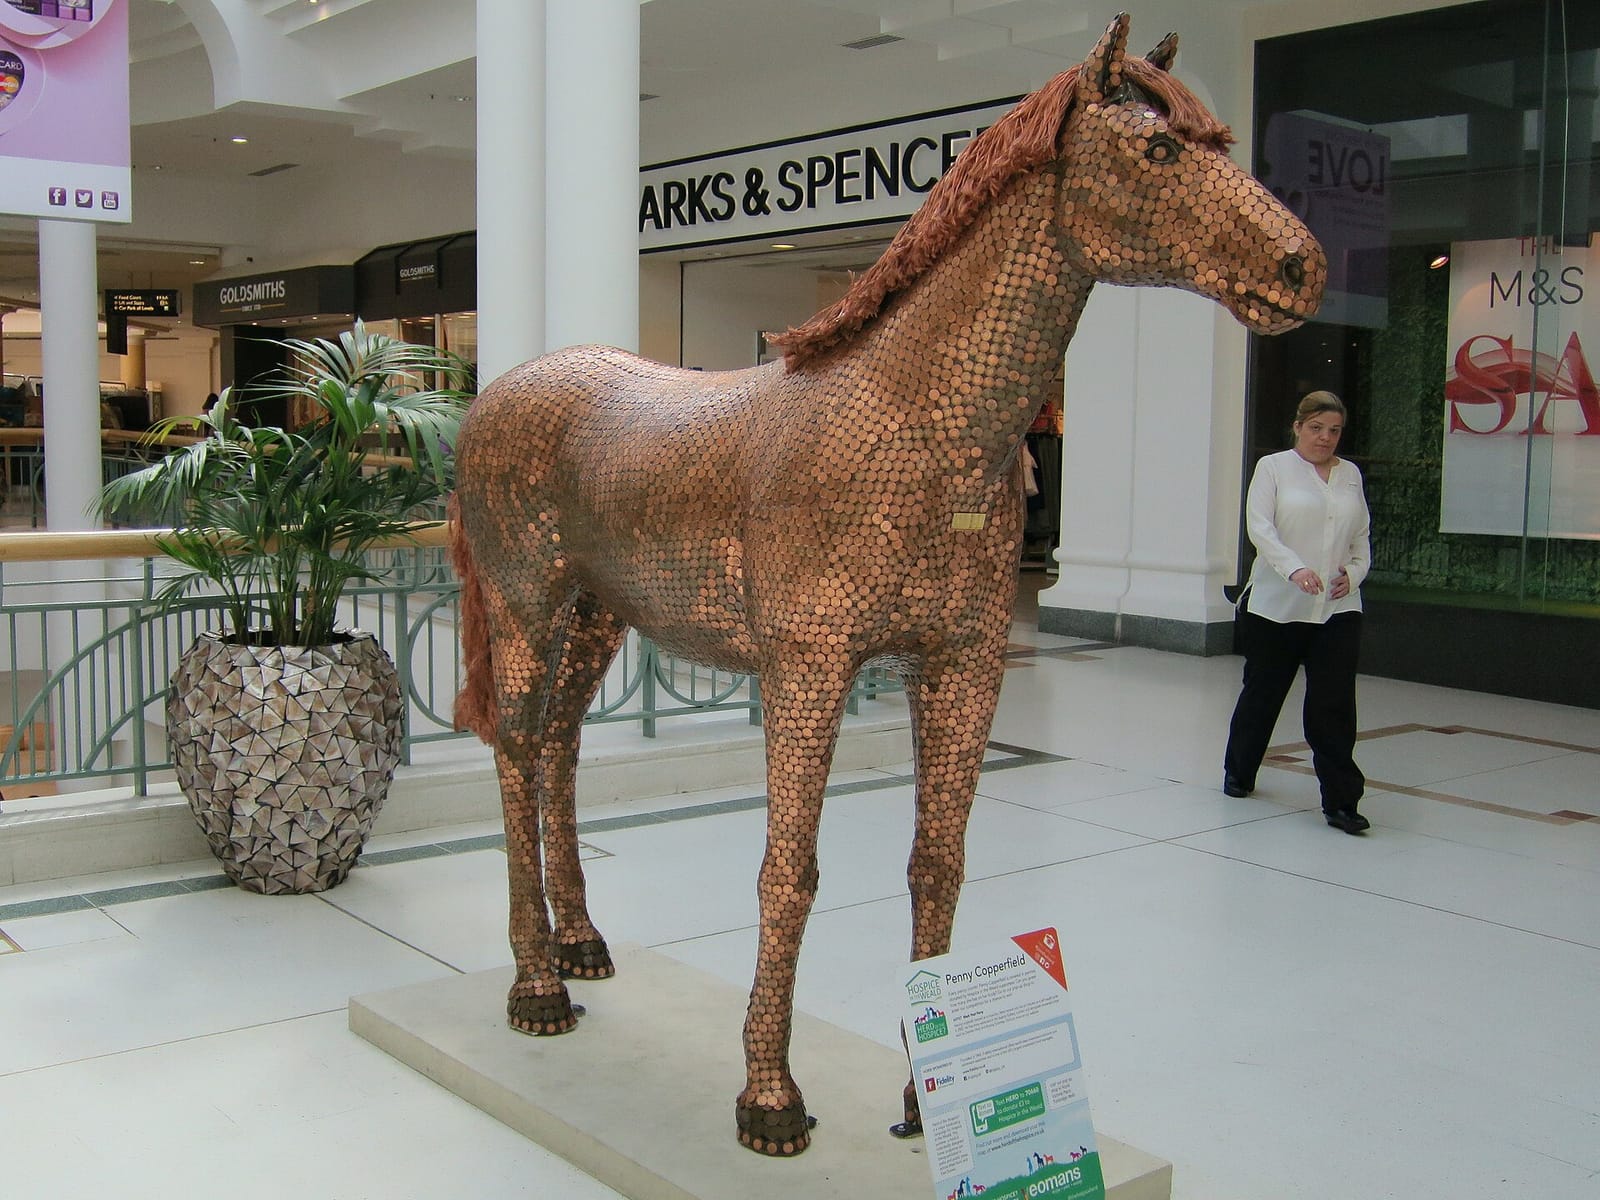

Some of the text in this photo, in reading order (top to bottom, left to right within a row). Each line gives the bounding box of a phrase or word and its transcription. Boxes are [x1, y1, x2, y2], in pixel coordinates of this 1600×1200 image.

[639, 127, 991, 233] ARKS & SPENCE
[400, 264, 435, 278] GOLDSMITHS
[219, 279, 286, 305] GOLDSMITHS
[1488, 266, 1584, 309] M&S
[945, 971, 973, 985] Penny
[975, 954, 1026, 978] Copperfield
[907, 979, 940, 995] HOSPICE
[919, 988, 942, 1000] WEALD
[937, 1075, 954, 1086] Fidelity
